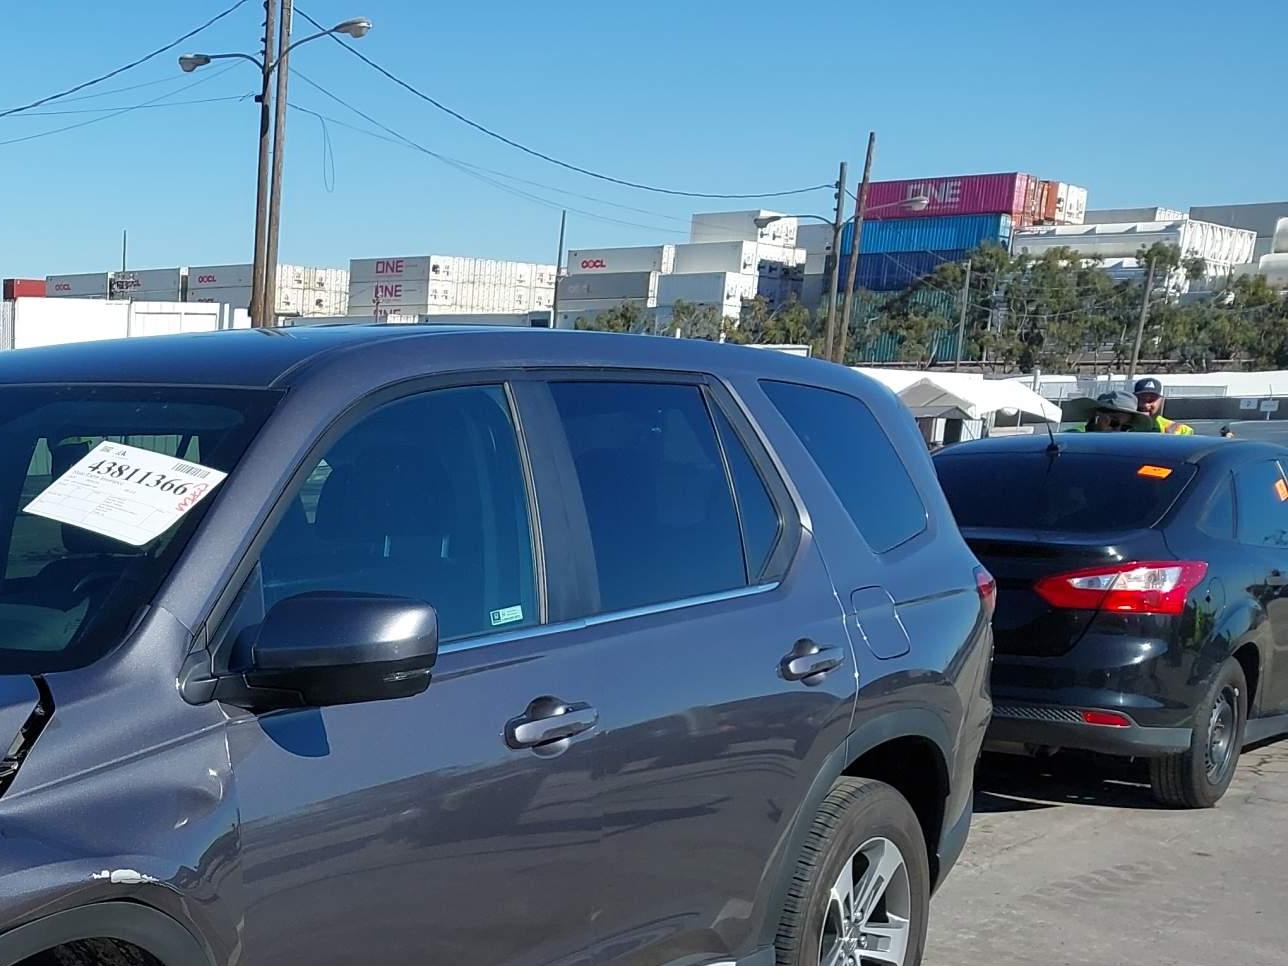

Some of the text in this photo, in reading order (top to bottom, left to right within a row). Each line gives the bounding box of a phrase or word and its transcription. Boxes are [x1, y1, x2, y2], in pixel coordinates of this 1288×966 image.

[376, 260, 404, 274] ONE
[581, 260, 607, 269] OOCL
[198, 275, 217, 283] OOCL
[375, 285, 403, 298] ONE
[88, 459, 192, 495] 43811366
